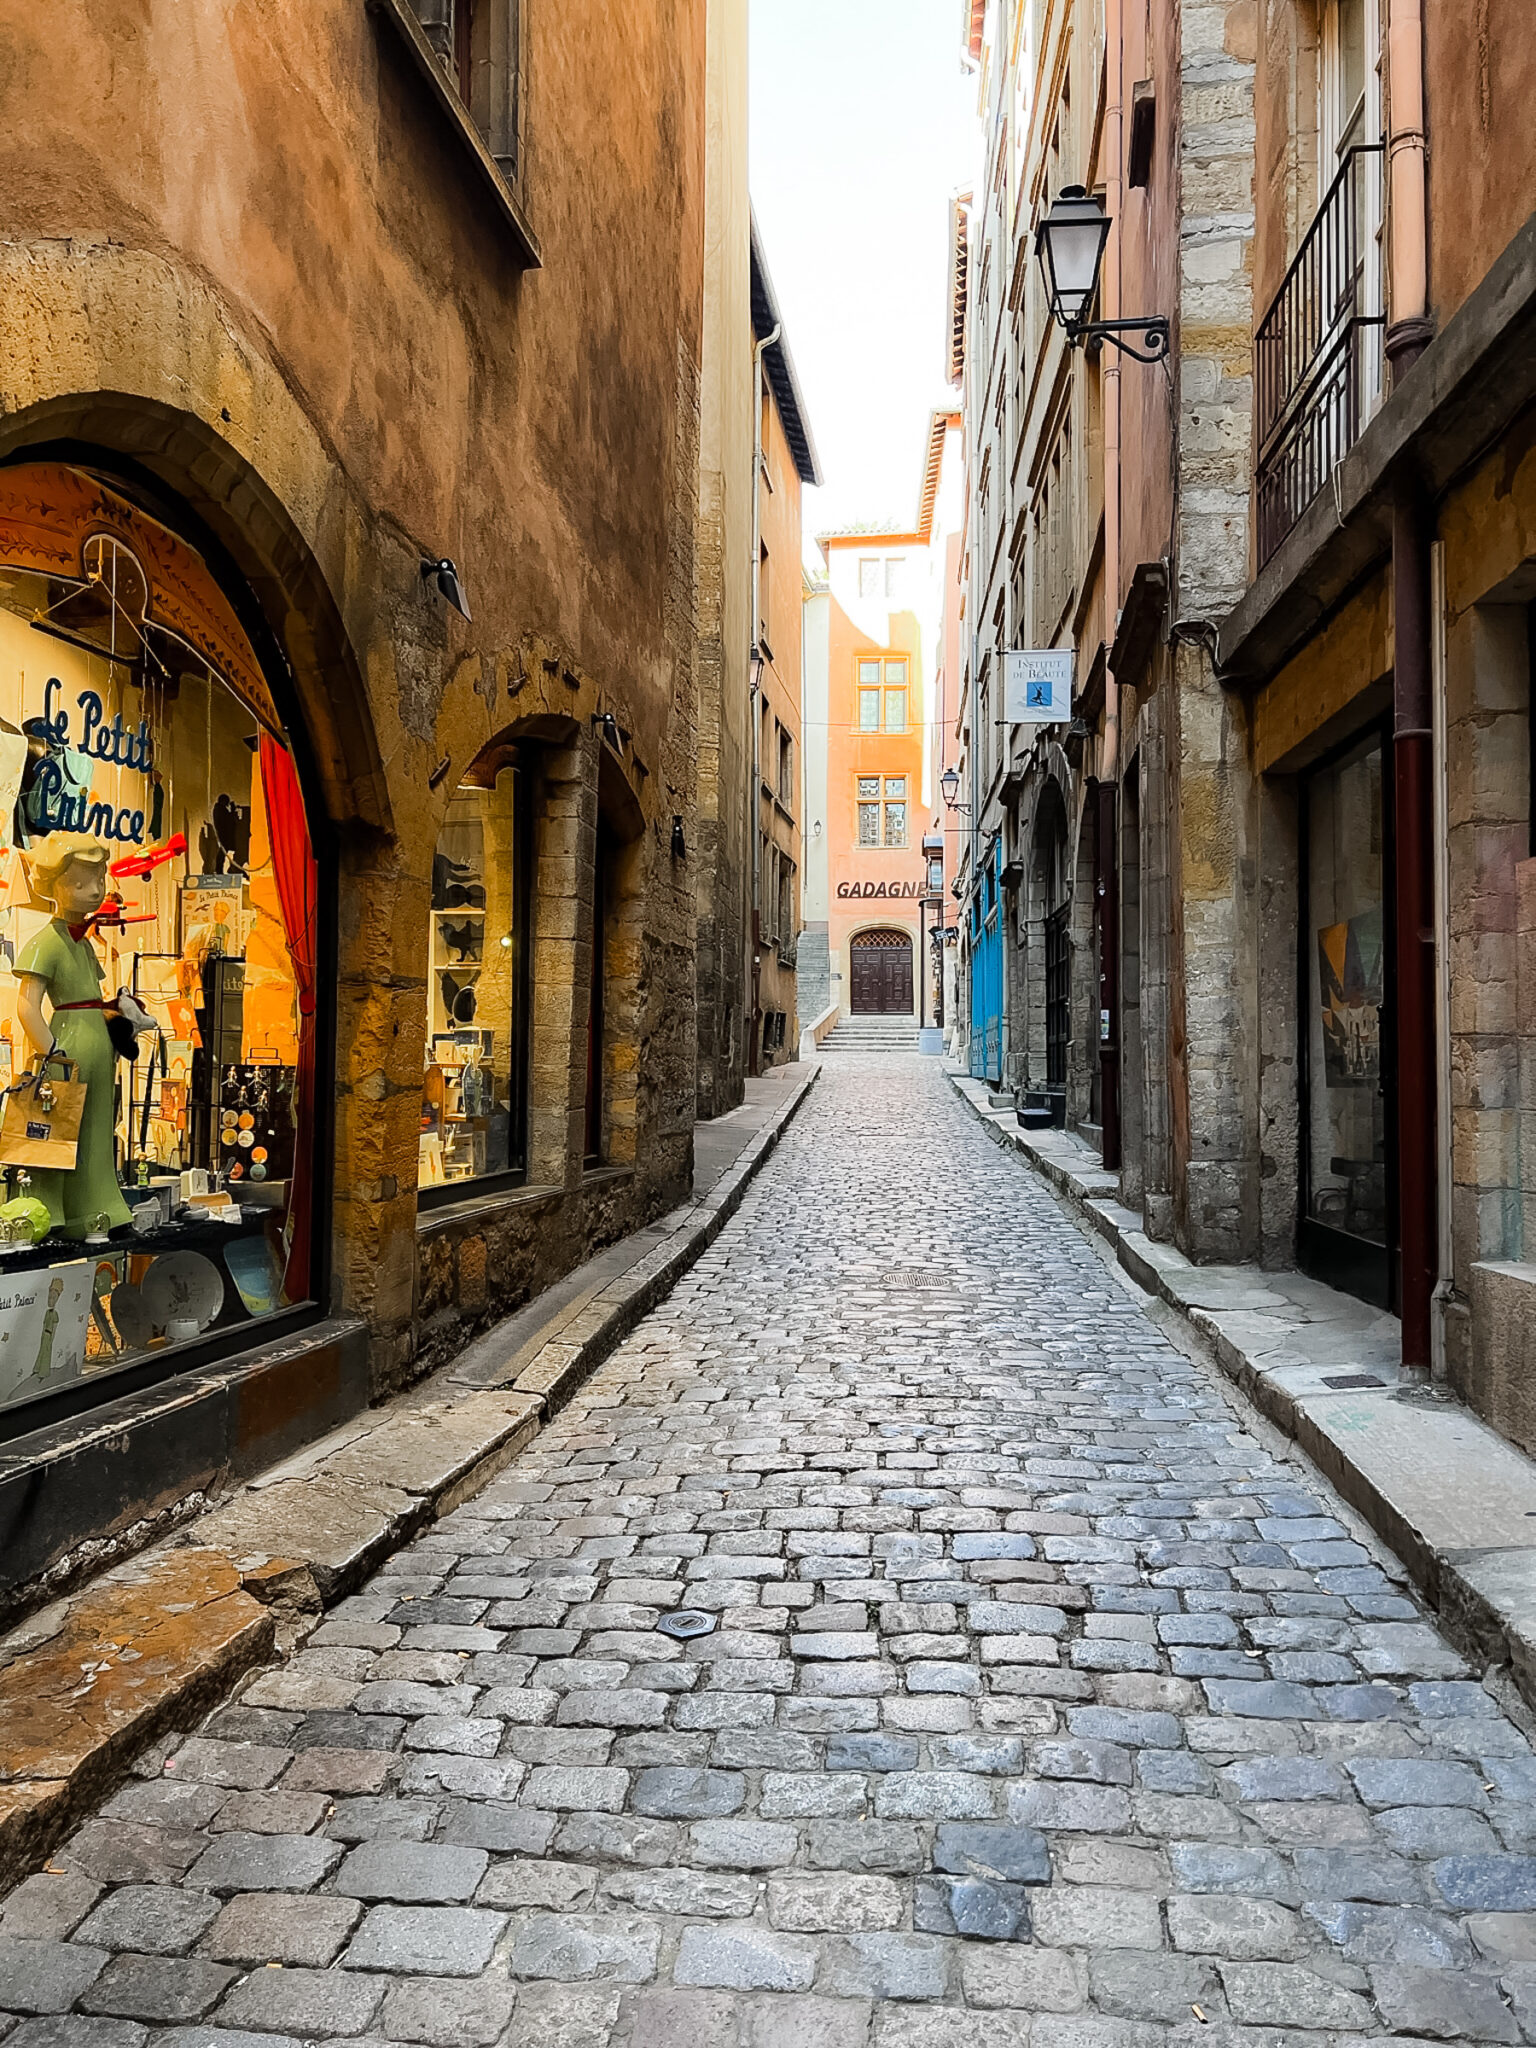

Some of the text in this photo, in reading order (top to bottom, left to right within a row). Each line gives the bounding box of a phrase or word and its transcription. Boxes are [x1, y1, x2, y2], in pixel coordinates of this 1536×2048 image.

[1018, 659, 1062, 669] INSTITUT
[1013, 671, 1025, 679] DE
[31, 677, 153, 773] Le Petit
[33, 758, 145, 844] Prince
[837, 881, 926, 898] GADAGNE
